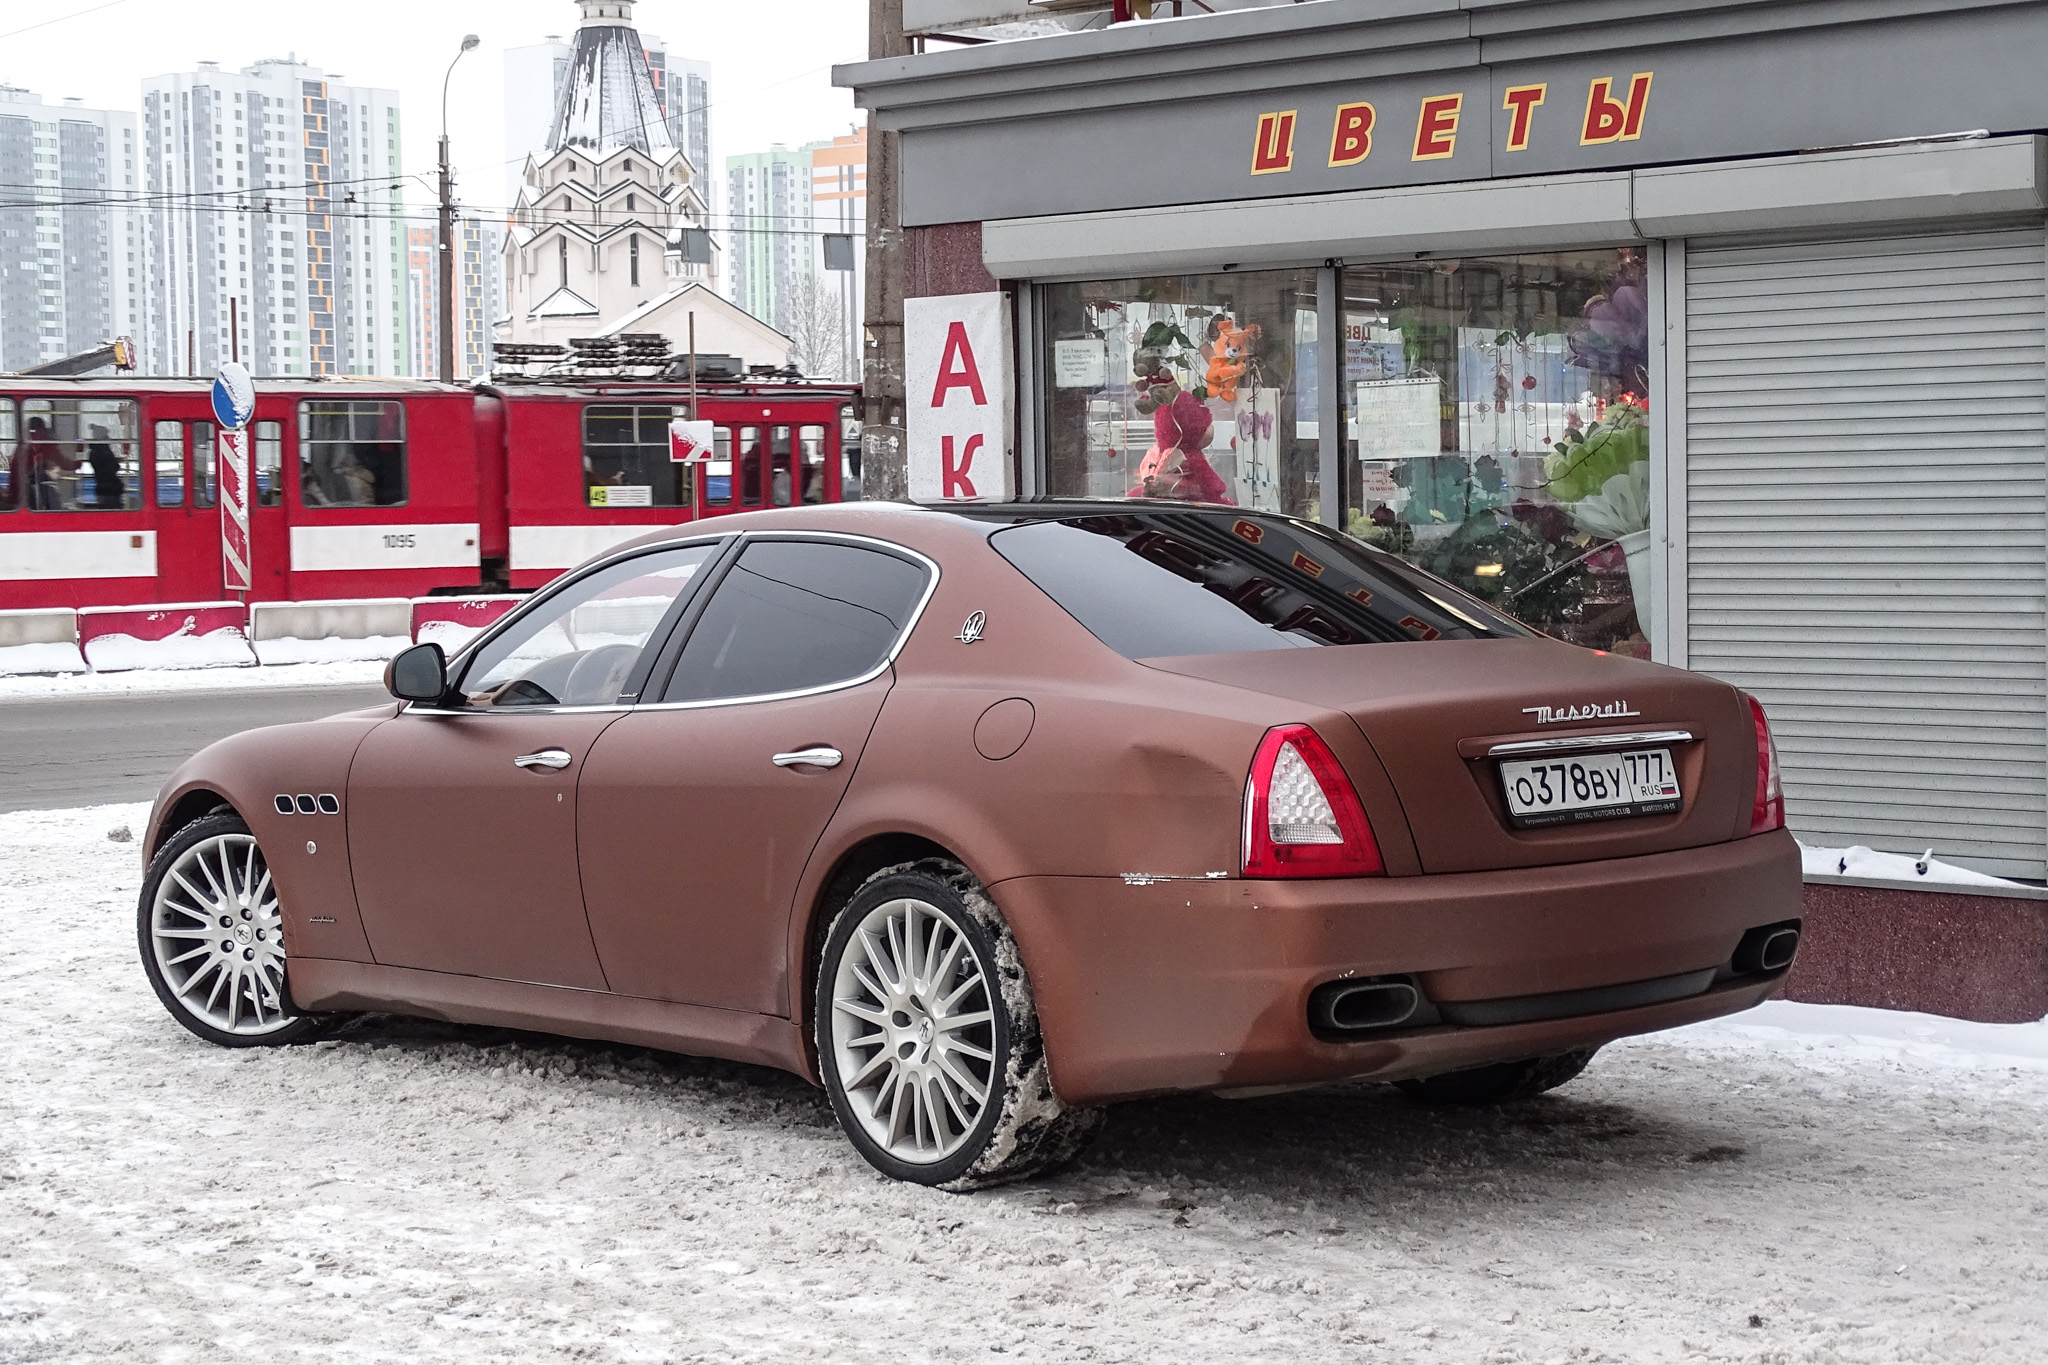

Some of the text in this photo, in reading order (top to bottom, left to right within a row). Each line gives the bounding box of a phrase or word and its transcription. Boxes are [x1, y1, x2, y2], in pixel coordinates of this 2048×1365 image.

[1250, 71, 1655, 177] ЦВЕТЫ
[382, 534, 416, 548] 1095
[1522, 700, 1641, 724] Maserati
[1624, 753, 1664, 785] 777
[1640, 784, 1661, 796] RUS
[1574, 807, 1631, 820] ROYAL MOTORS CLUB
